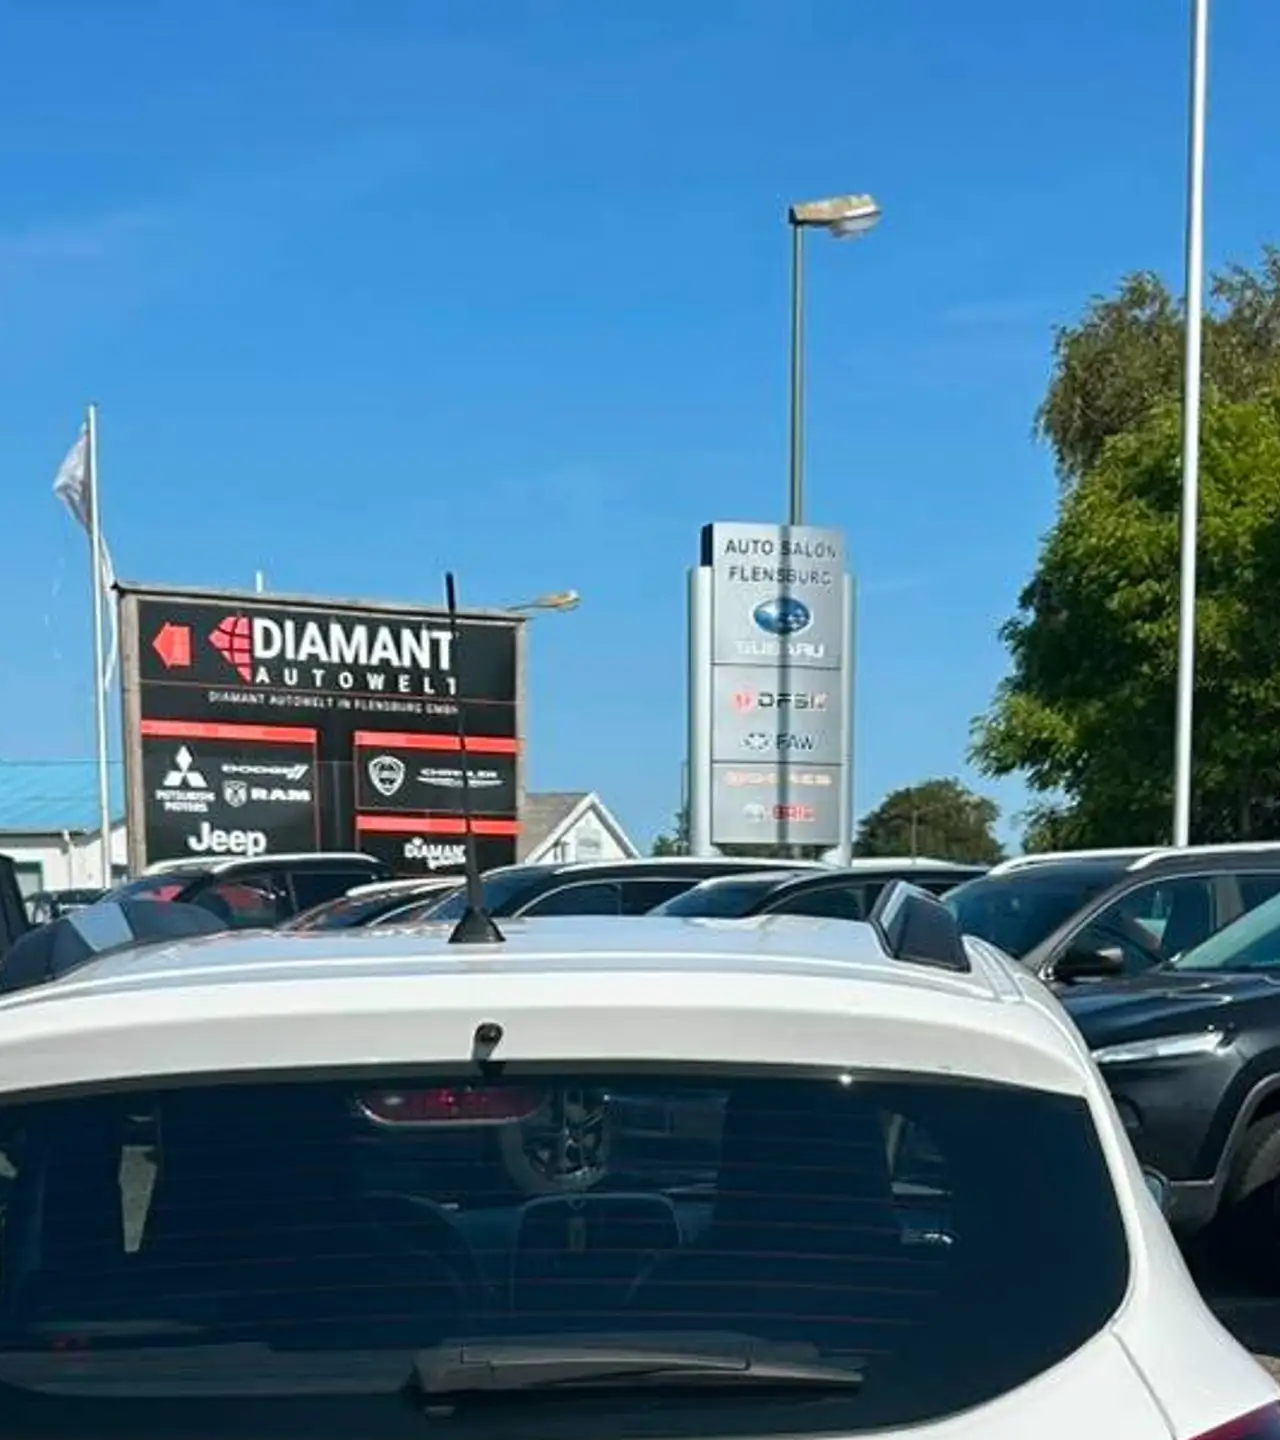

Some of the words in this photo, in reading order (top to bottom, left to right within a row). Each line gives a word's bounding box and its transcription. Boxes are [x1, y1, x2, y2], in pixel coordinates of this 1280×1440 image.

[725, 539, 774, 556] AUTO
[780, 540, 836, 558] SALON
[729, 565, 832, 585] FLENSBURG
[252, 617, 454, 671] DIAMANT
[255, 667, 457, 695] AUTOWELT
[208, 690, 266, 705] DIAMANT
[270, 694, 334, 709] AUTOWELT
[338, 699, 351, 710] IN
[354, 700, 421, 714] FLENSBURG
[776, 733, 813, 750] FAW
[251, 787, 311, 801] RAM
[187, 821, 267, 856] Jeep
